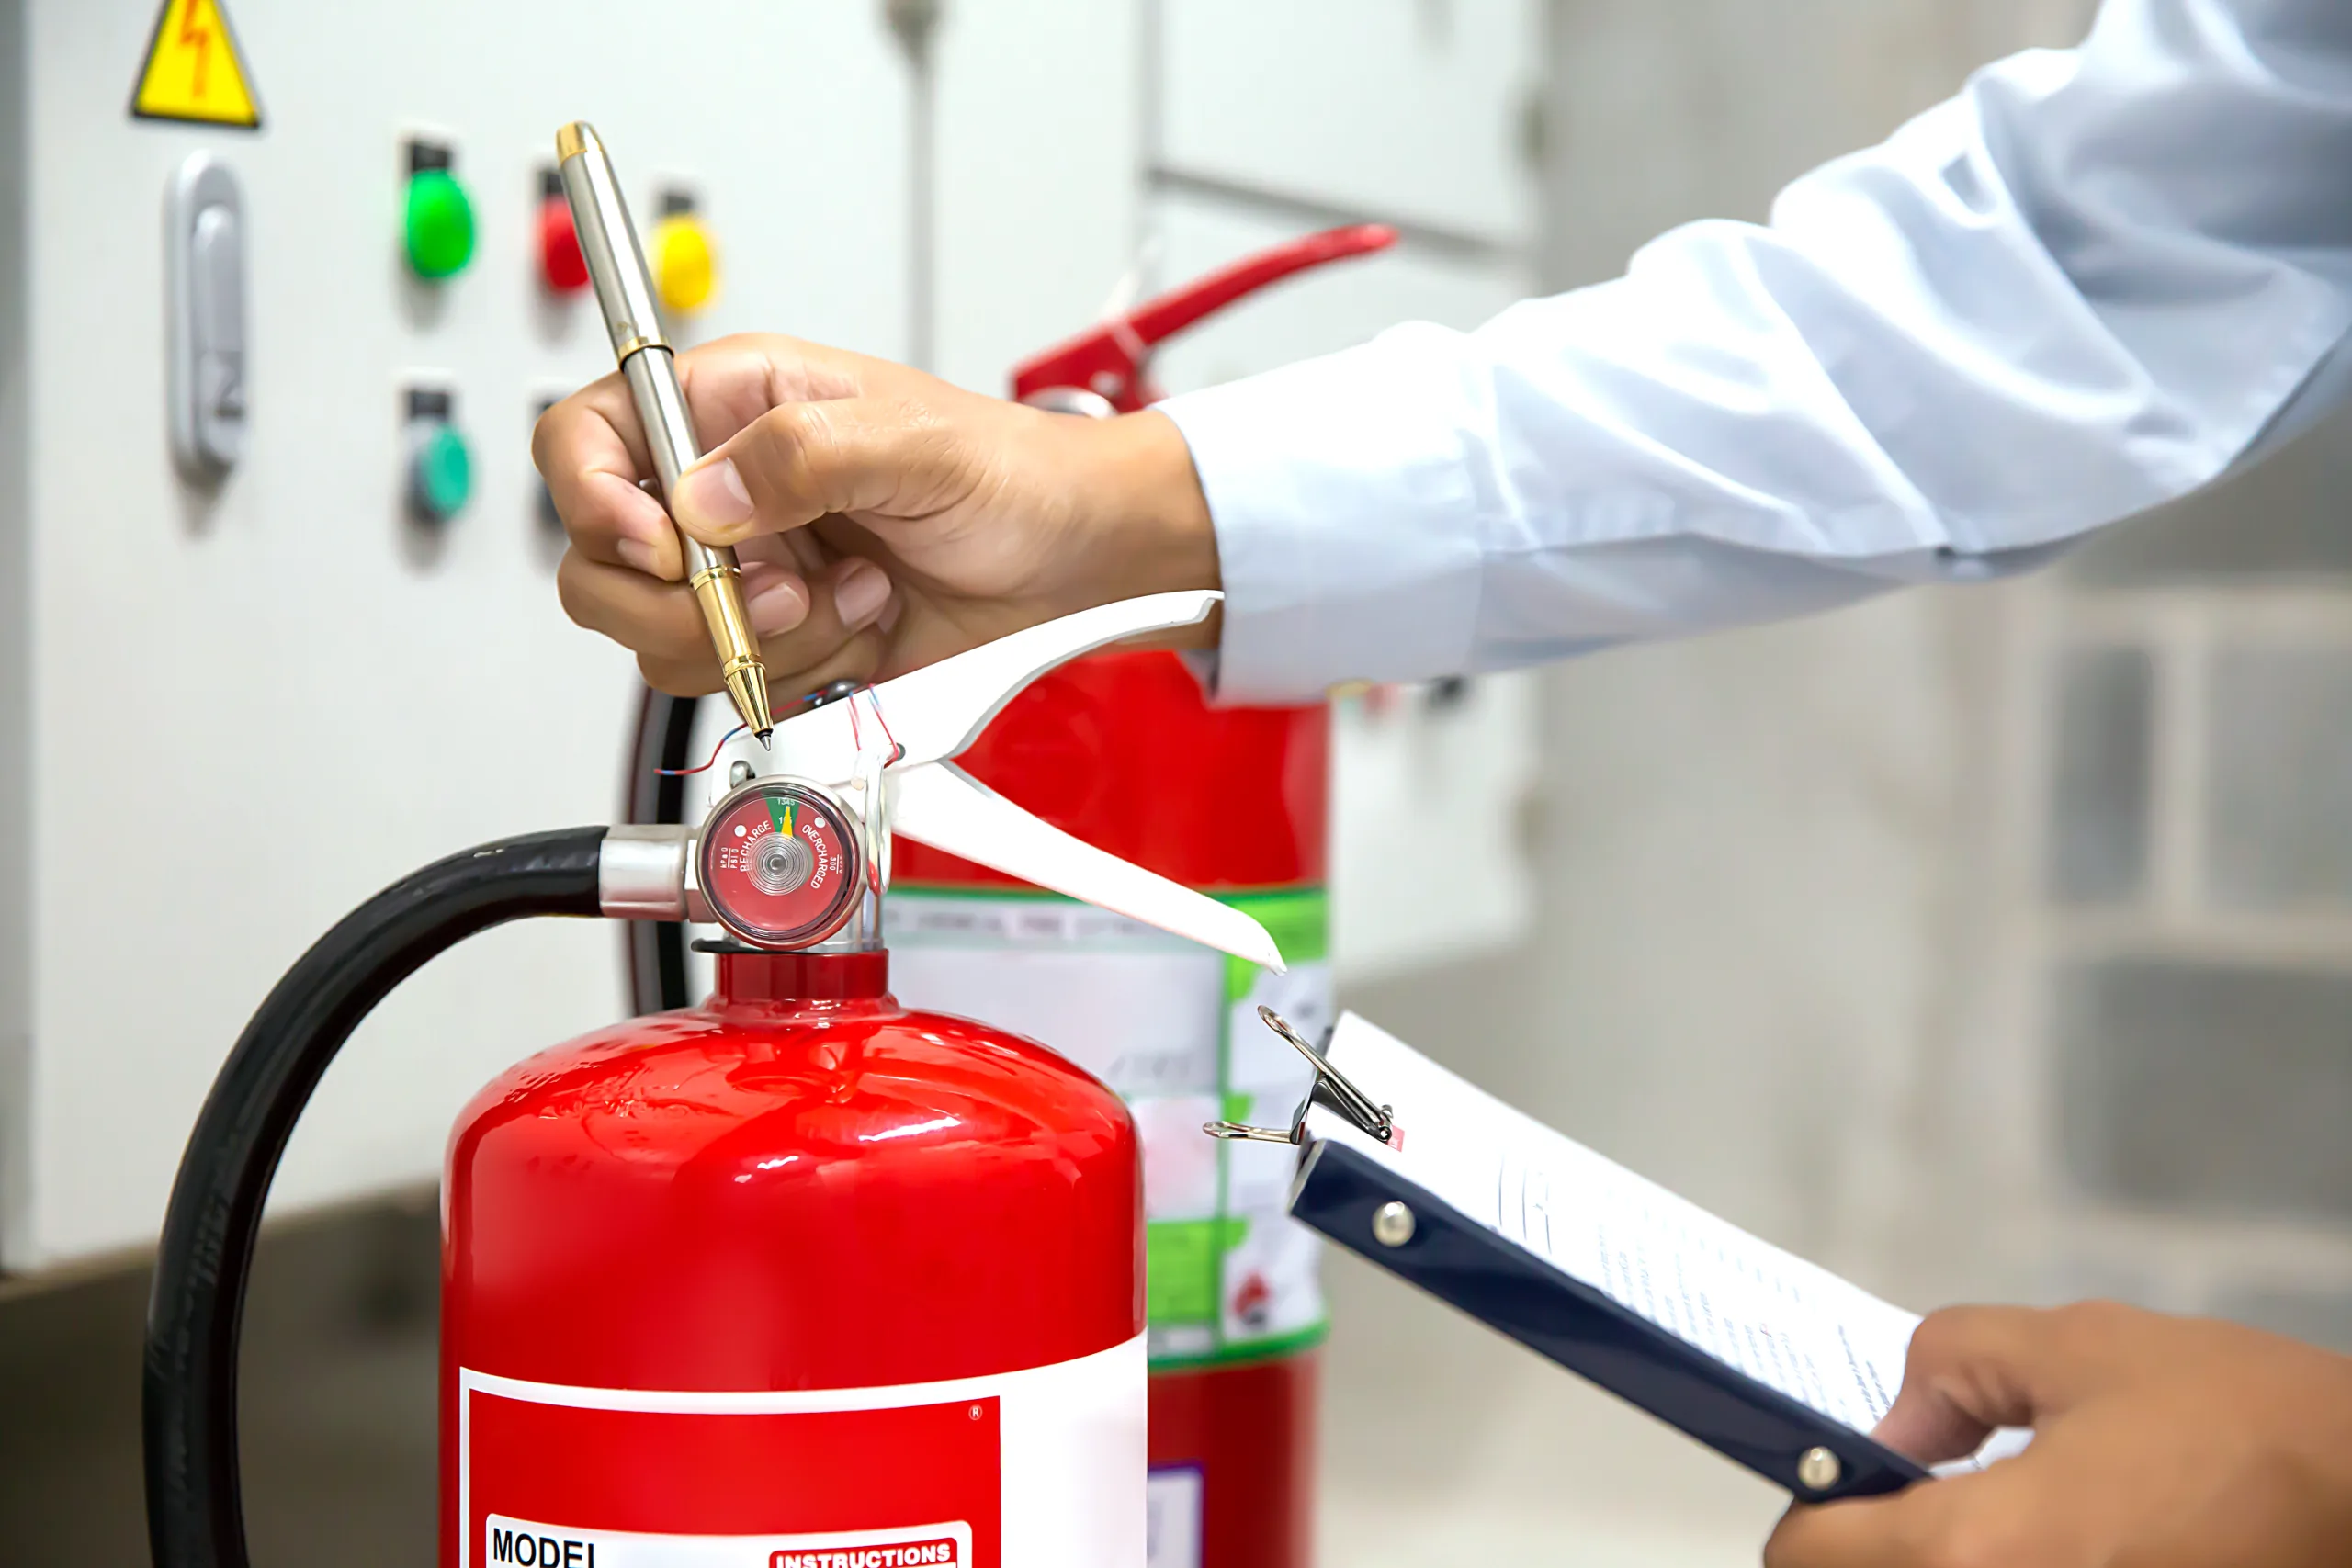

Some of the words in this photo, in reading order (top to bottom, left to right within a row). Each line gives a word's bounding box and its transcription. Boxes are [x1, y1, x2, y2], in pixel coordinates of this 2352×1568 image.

[777, 797, 796, 807] 1345
[739, 820, 772, 872] RECHARGE
[730, 855, 739, 869] PSI
[801, 824, 829, 889] OVERCHARGED
[829, 856, 837, 871] 300
[775, 1543, 952, 1568] INSTRUCTIONS
